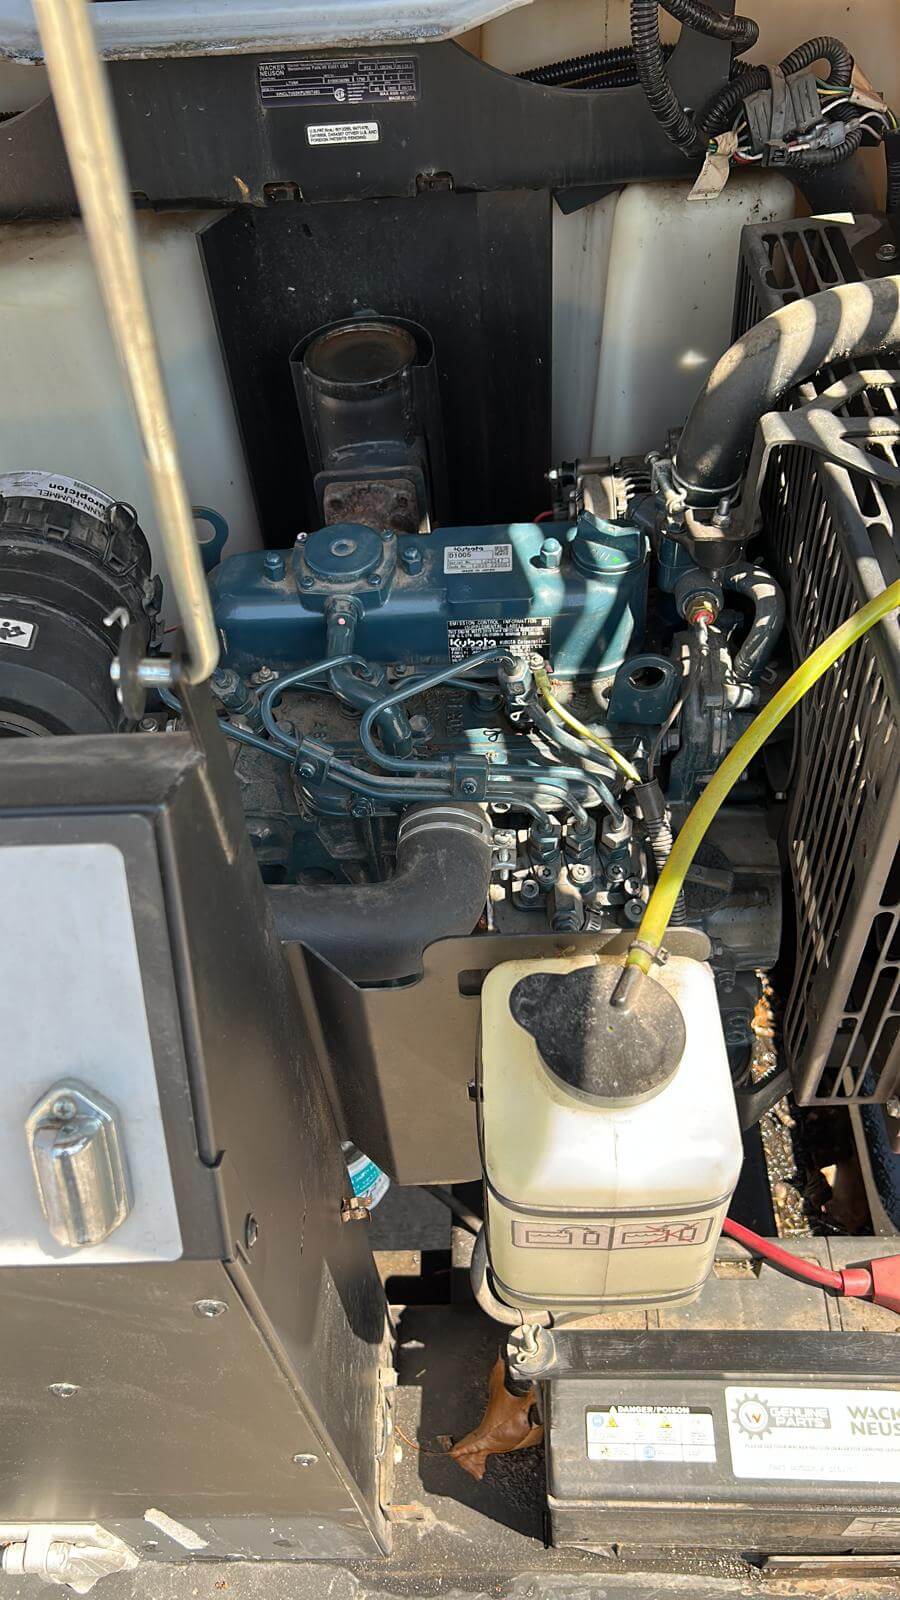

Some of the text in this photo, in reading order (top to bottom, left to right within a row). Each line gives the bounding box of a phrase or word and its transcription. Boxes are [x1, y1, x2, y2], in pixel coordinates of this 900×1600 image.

[449, 638, 497, 647] Kubota
[617, 1405, 690, 1415] DANGER/POISON
[769, 1407, 829, 1418] GENUINE
[775, 1416, 826, 1428] PARTS
